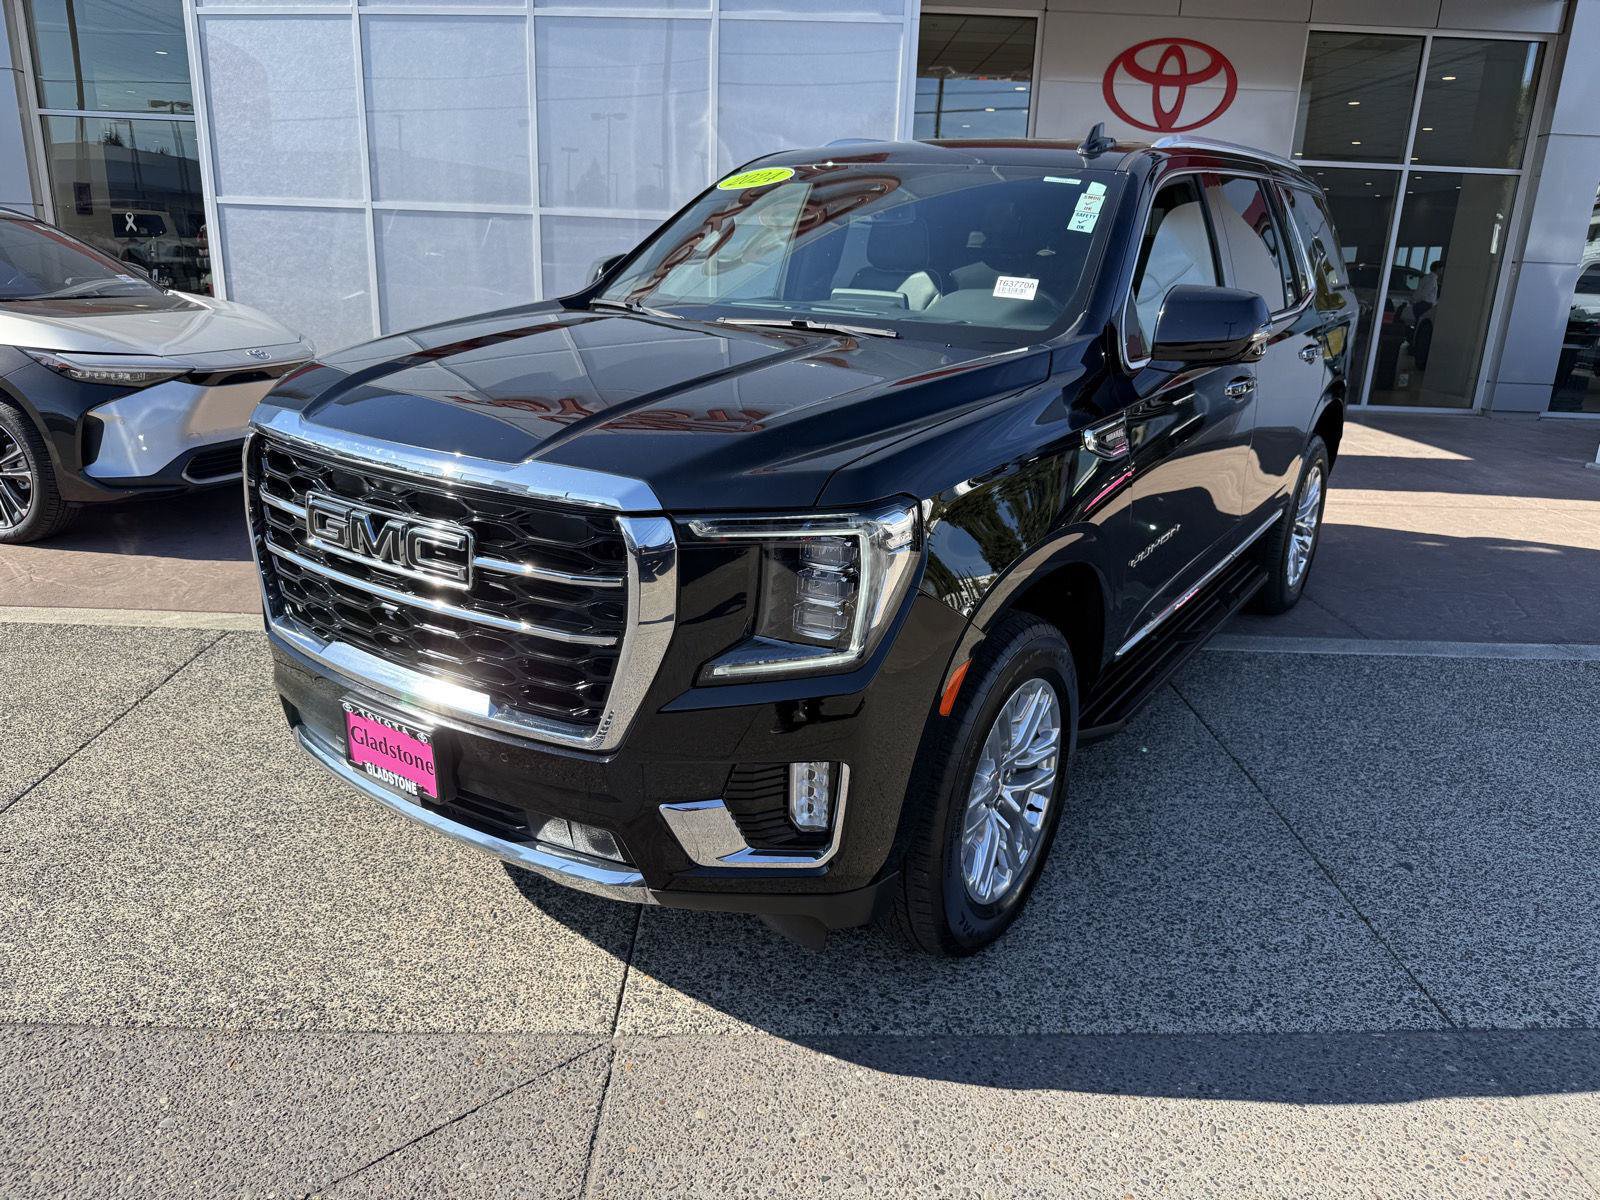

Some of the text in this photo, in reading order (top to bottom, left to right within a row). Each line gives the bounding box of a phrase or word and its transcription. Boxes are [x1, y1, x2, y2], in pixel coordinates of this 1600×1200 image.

[1076, 212, 1096, 220] SAFETY
[308, 498, 468, 582] GMC
[350, 725, 435, 776] Gladstone
[364, 762, 418, 796] GLADSTONE
